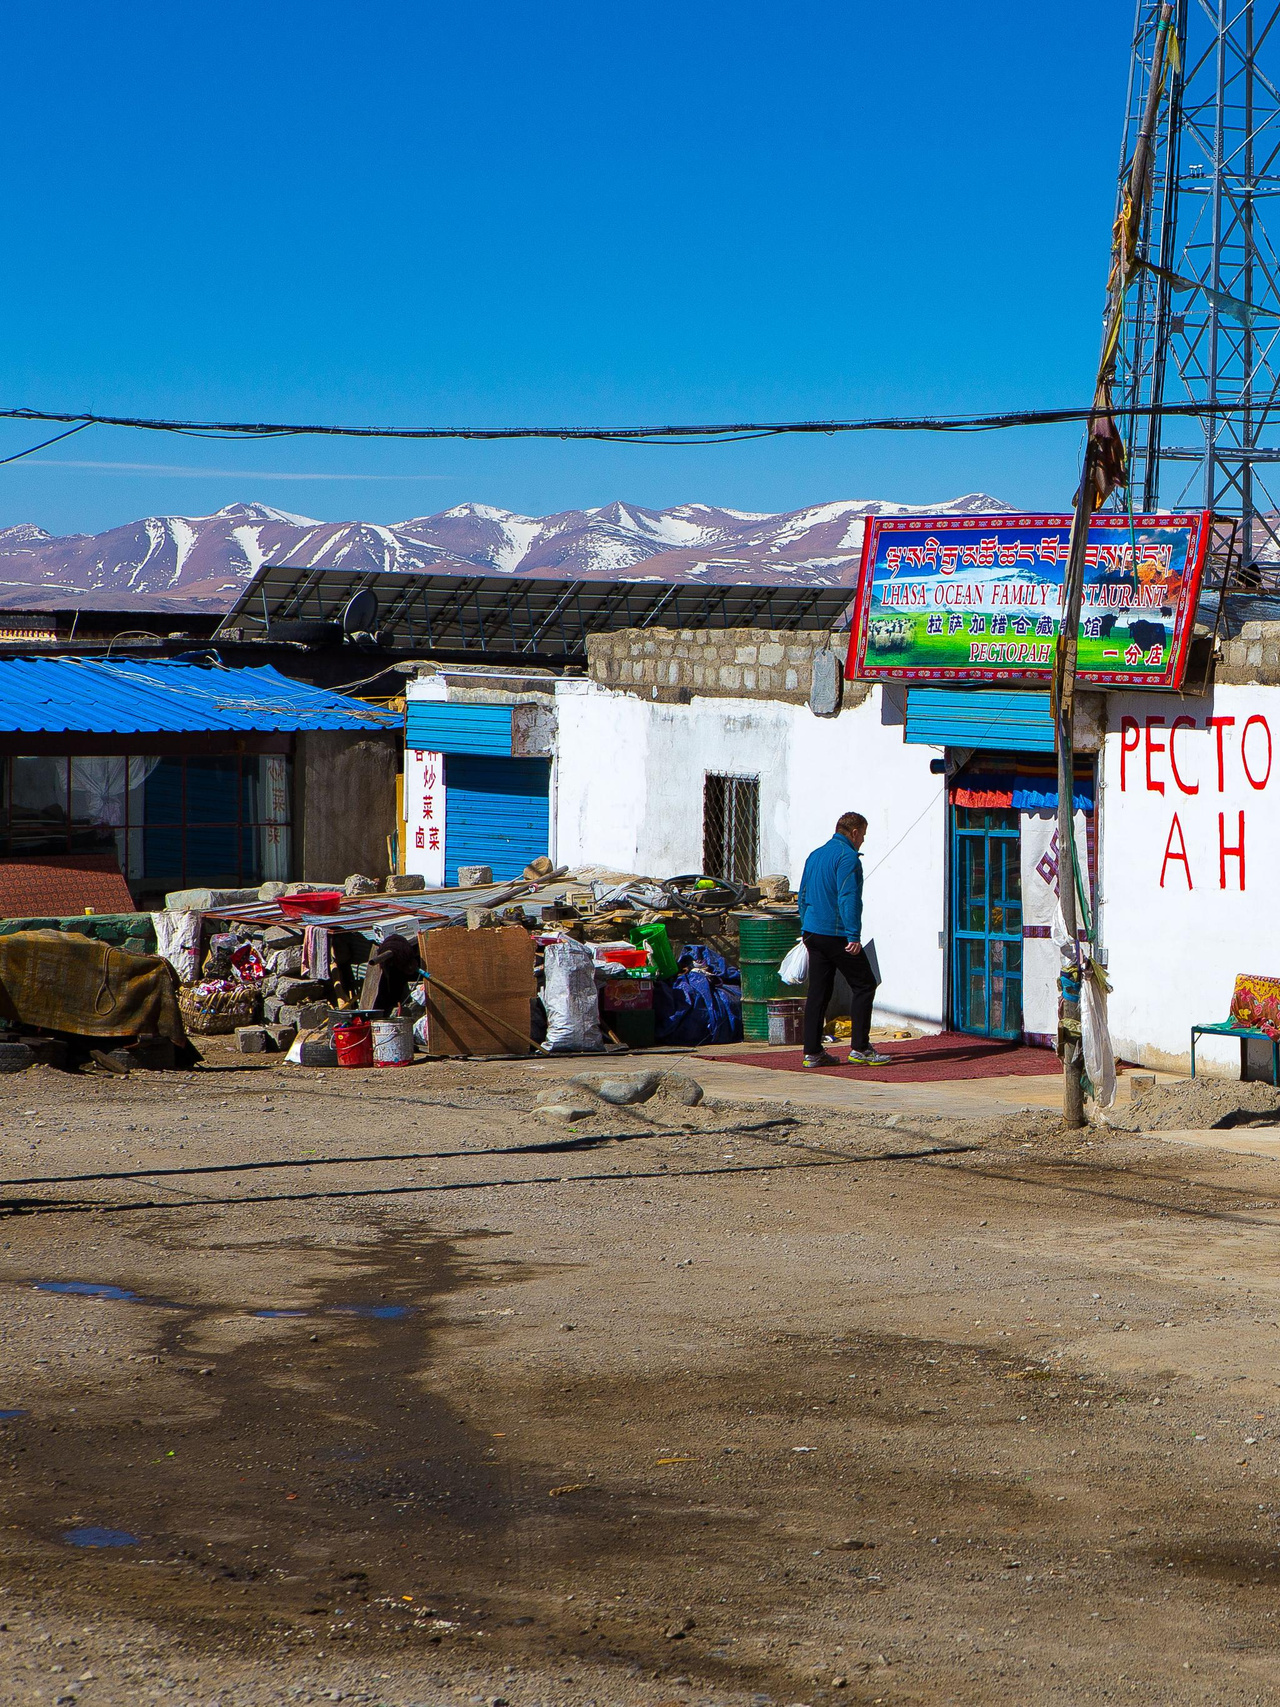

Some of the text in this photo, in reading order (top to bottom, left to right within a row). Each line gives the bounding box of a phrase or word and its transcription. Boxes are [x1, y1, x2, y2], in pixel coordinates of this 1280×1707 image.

[881, 583, 1168, 608] LHASA OCEAN FAMILY STAURANT
[969, 642, 1052, 664] РЕСТОРАН
[1103, 643, 1163, 666] 一分店
[1160, 810, 1246, 890] АН
